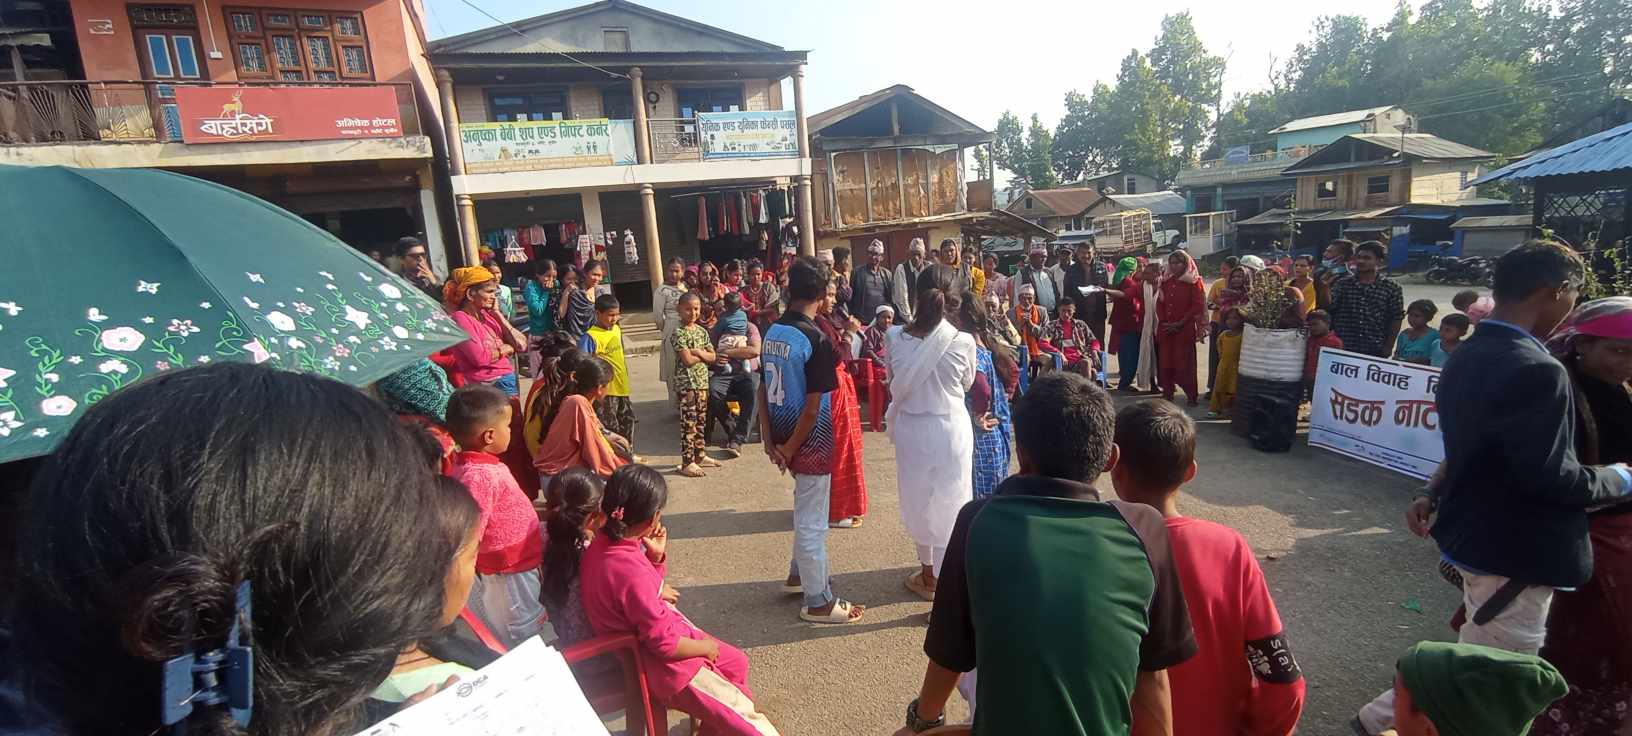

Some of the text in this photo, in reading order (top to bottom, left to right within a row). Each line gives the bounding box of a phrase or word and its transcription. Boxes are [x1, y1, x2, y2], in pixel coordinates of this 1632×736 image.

[372, 117, 397, 127] होटल
[462, 129, 497, 146] अनुष्का
[500, 124, 516, 141] बेबी
[537, 126, 557, 140] एण्ड
[1330, 360, 1360, 379] बाल
[1366, 363, 1412, 391] विवाह
[1330, 387, 1385, 427] सडक
[1394, 399, 1440, 431] नाट
